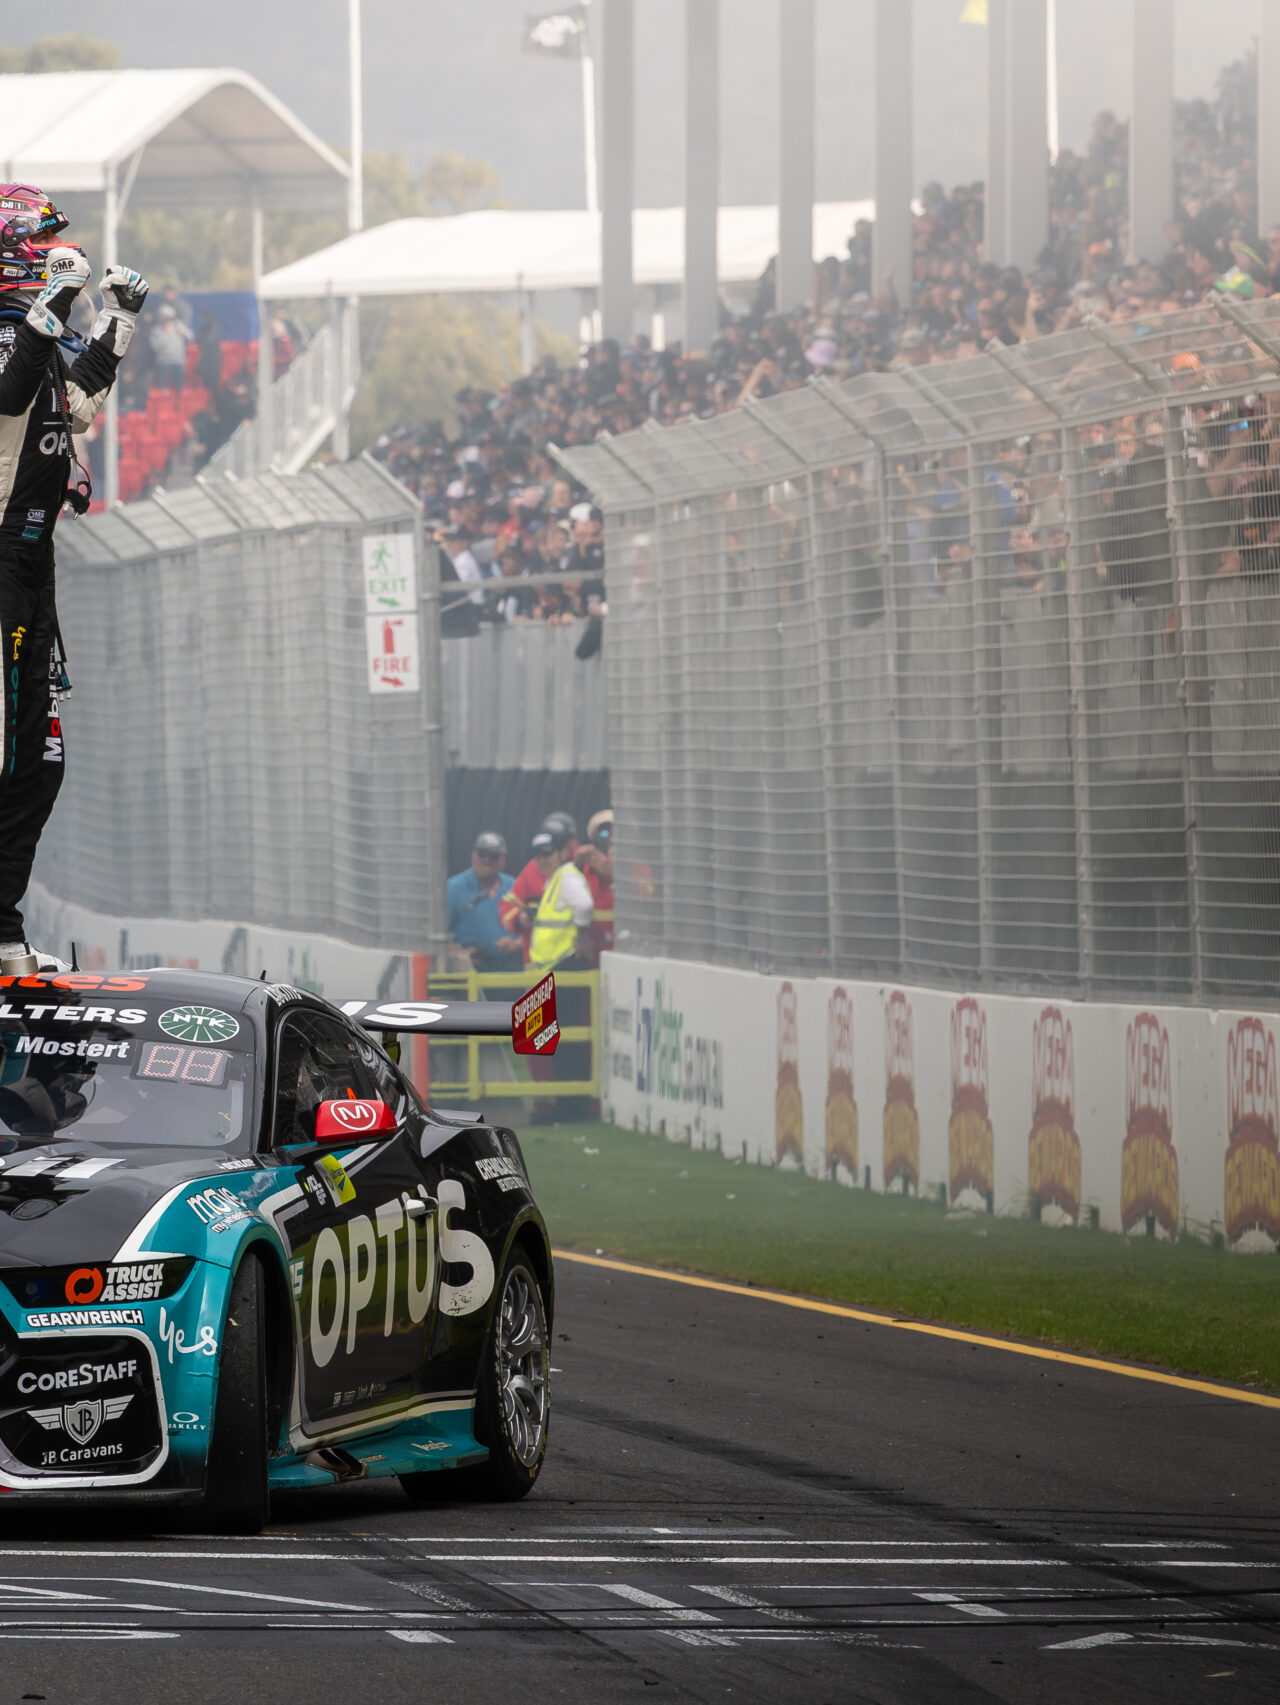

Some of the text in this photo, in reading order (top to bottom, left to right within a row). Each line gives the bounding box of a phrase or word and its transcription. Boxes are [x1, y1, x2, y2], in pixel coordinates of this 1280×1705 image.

[37, 218, 57, 230] OPTUS
[50, 260, 75, 273] OMP
[27, 511, 45, 519] OMP
[369, 577, 408, 594] EXIT
[373, 656, 411, 673] FIRE
[514, 976, 553, 1029] SUPERCHEAP
[172, 1013, 228, 1028] NTK
[527, 1012, 542, 1034] AUTO
[15, 1036, 131, 1058] Mostert
[1033, 1005, 1075, 1120] MEGA
[1126, 1012, 1173, 1138] MEGA
[1227, 1016, 1280, 1145] MEGA
[185, 1186, 248, 1224] move
[105, 1263, 165, 1284] TRUCK
[310, 1179, 496, 1368] OPTUS
[100, 1281, 163, 1302] ASSIST
[26, 1310, 144, 1328] GEARWRENCH
[60, 1442, 124, 1461] Caravans
